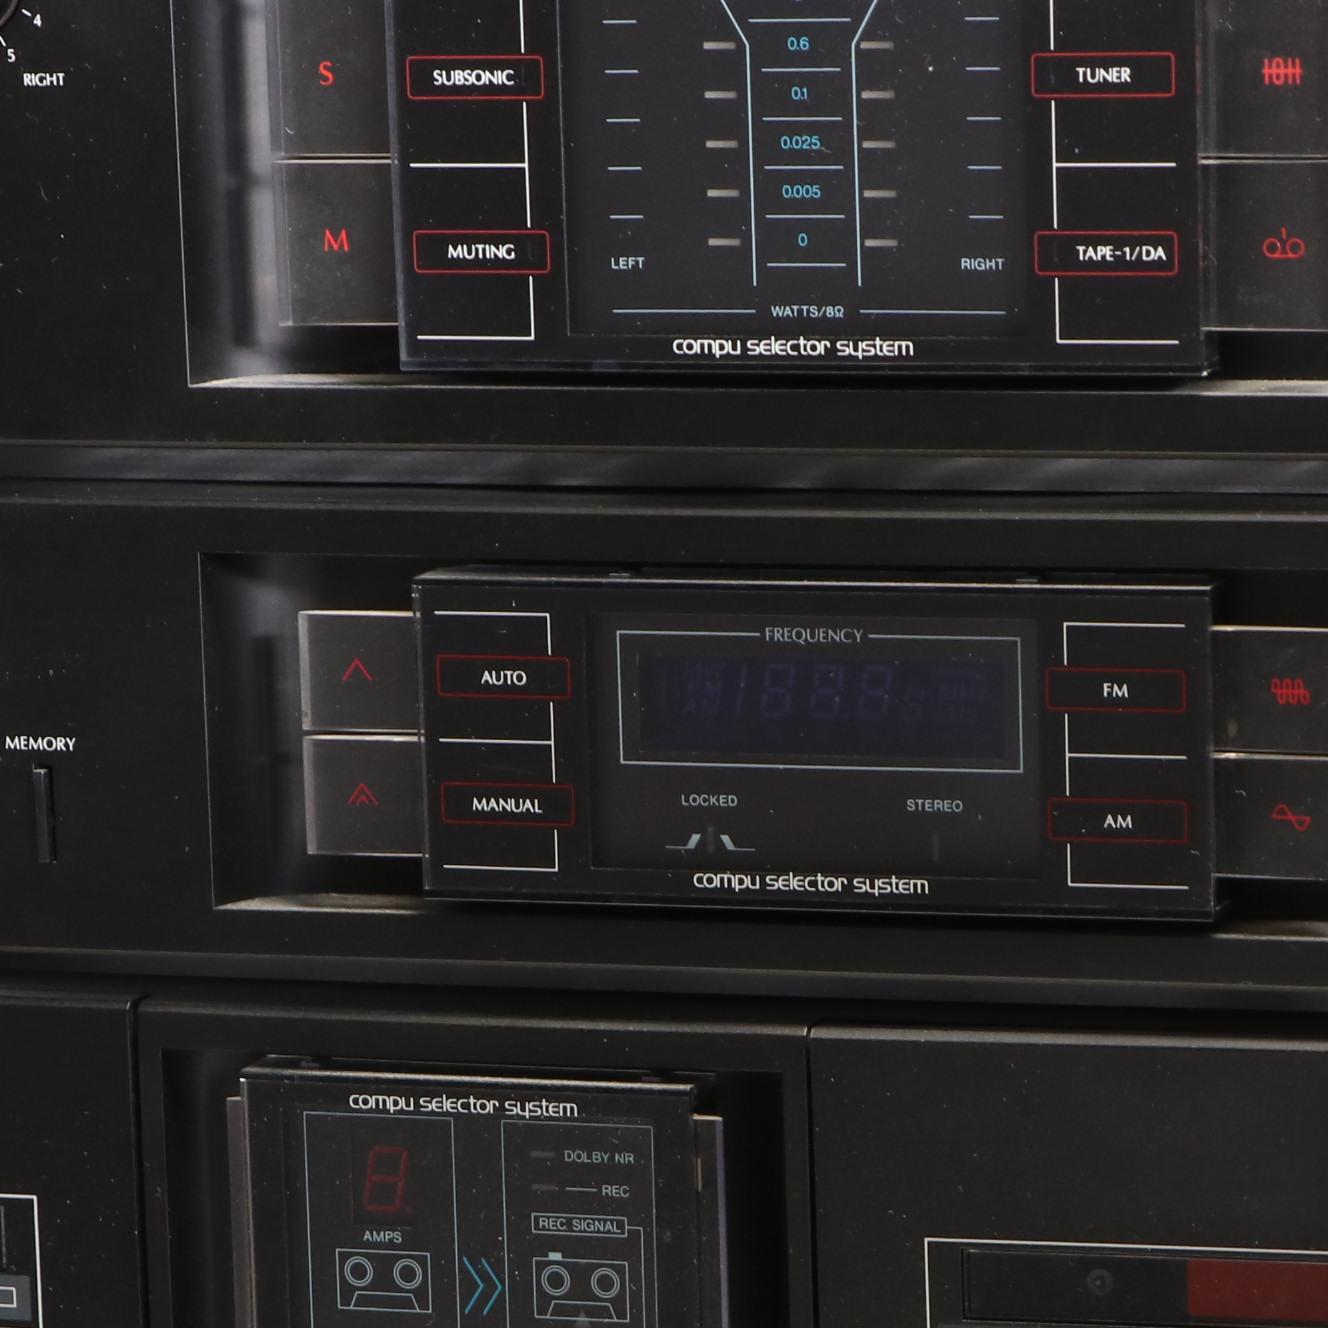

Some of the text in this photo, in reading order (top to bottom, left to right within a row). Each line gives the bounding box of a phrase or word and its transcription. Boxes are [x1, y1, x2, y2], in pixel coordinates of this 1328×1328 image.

[787, 37, 809, 51] 0.6
[23, 73, 64, 86] RIGHT
[433, 69, 515, 86] SUBSONIC
[1076, 67, 1131, 83] TUNER
[780, 136, 820, 149] 0.025
[782, 185, 821, 199] 0.005
[447, 243, 515, 260] MUTING
[1076, 245, 1167, 262] TAPE-1/DA
[771, 305, 844, 318] WATTS/8Ω
[672, 335, 914, 360] compu selector system
[765, 627, 863, 645] FREQUENCY
[481, 670, 527, 686] AUTO
[1102, 682, 1129, 699] FM
[5, 736, 75, 752] MEMORY
[473, 796, 543, 814] MANUAL
[681, 793, 738, 807] LOCKED
[906, 799, 963, 813] STEREO
[1103, 813, 1132, 829] AM
[693, 872, 929, 897] compu selector system
[349, 1094, 578, 1119] compu selector system
[564, 1150, 634, 1164] DOLBY NR
[601, 1185, 630, 1198] REC
[363, 1230, 402, 1243] AMPS
